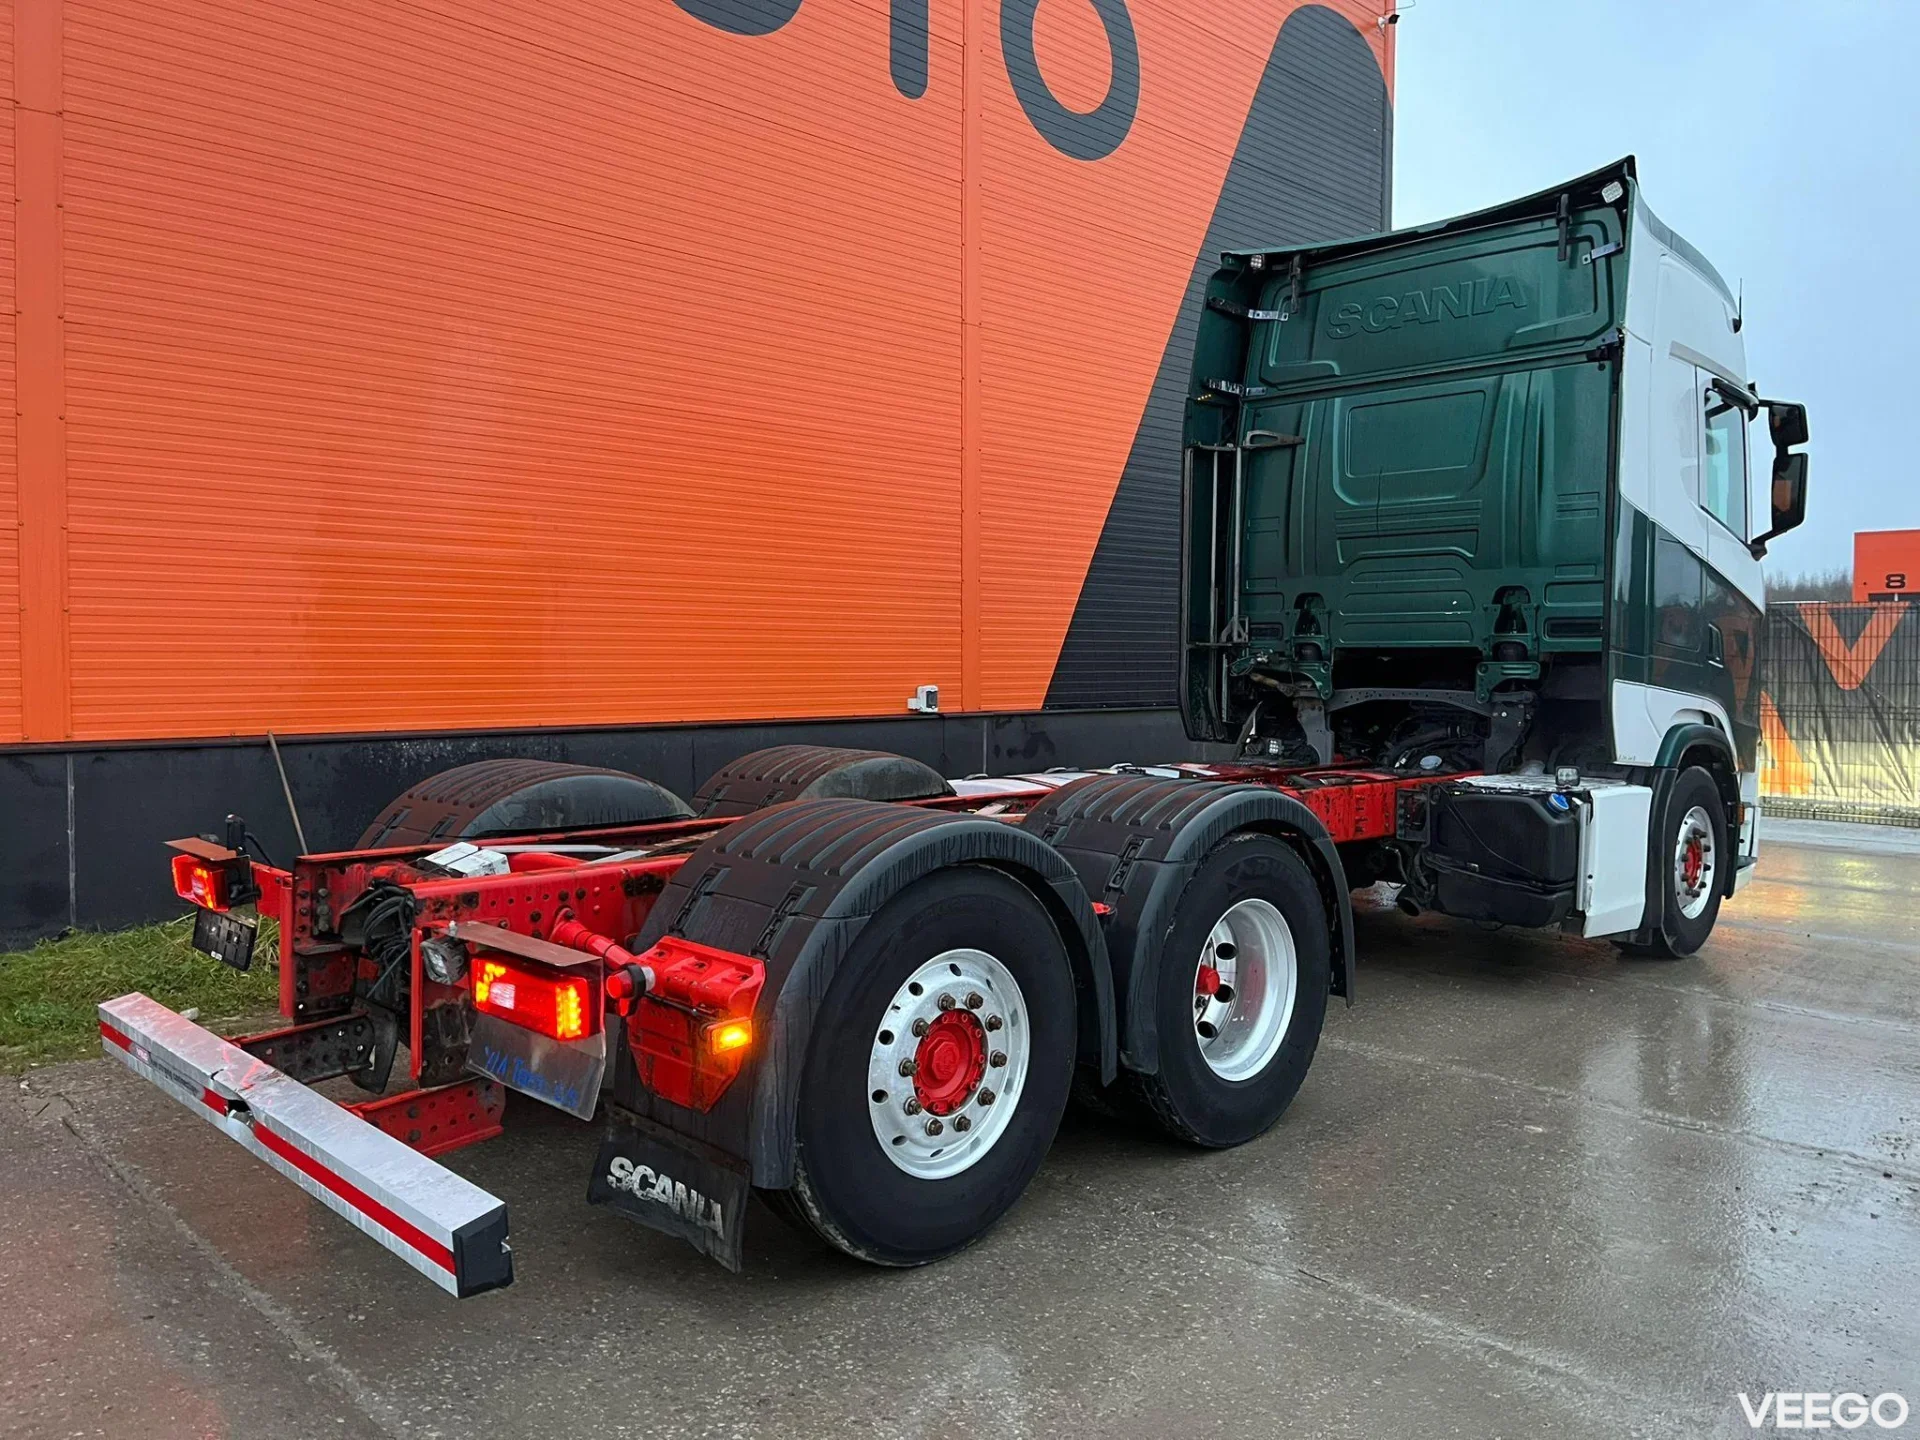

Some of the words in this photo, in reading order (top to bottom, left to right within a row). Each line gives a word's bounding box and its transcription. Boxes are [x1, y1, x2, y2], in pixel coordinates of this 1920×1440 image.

[1326, 275, 1527, 340] SCANIA
[1885, 573, 1906, 589] 8
[607, 1156, 724, 1240] SCANIA
